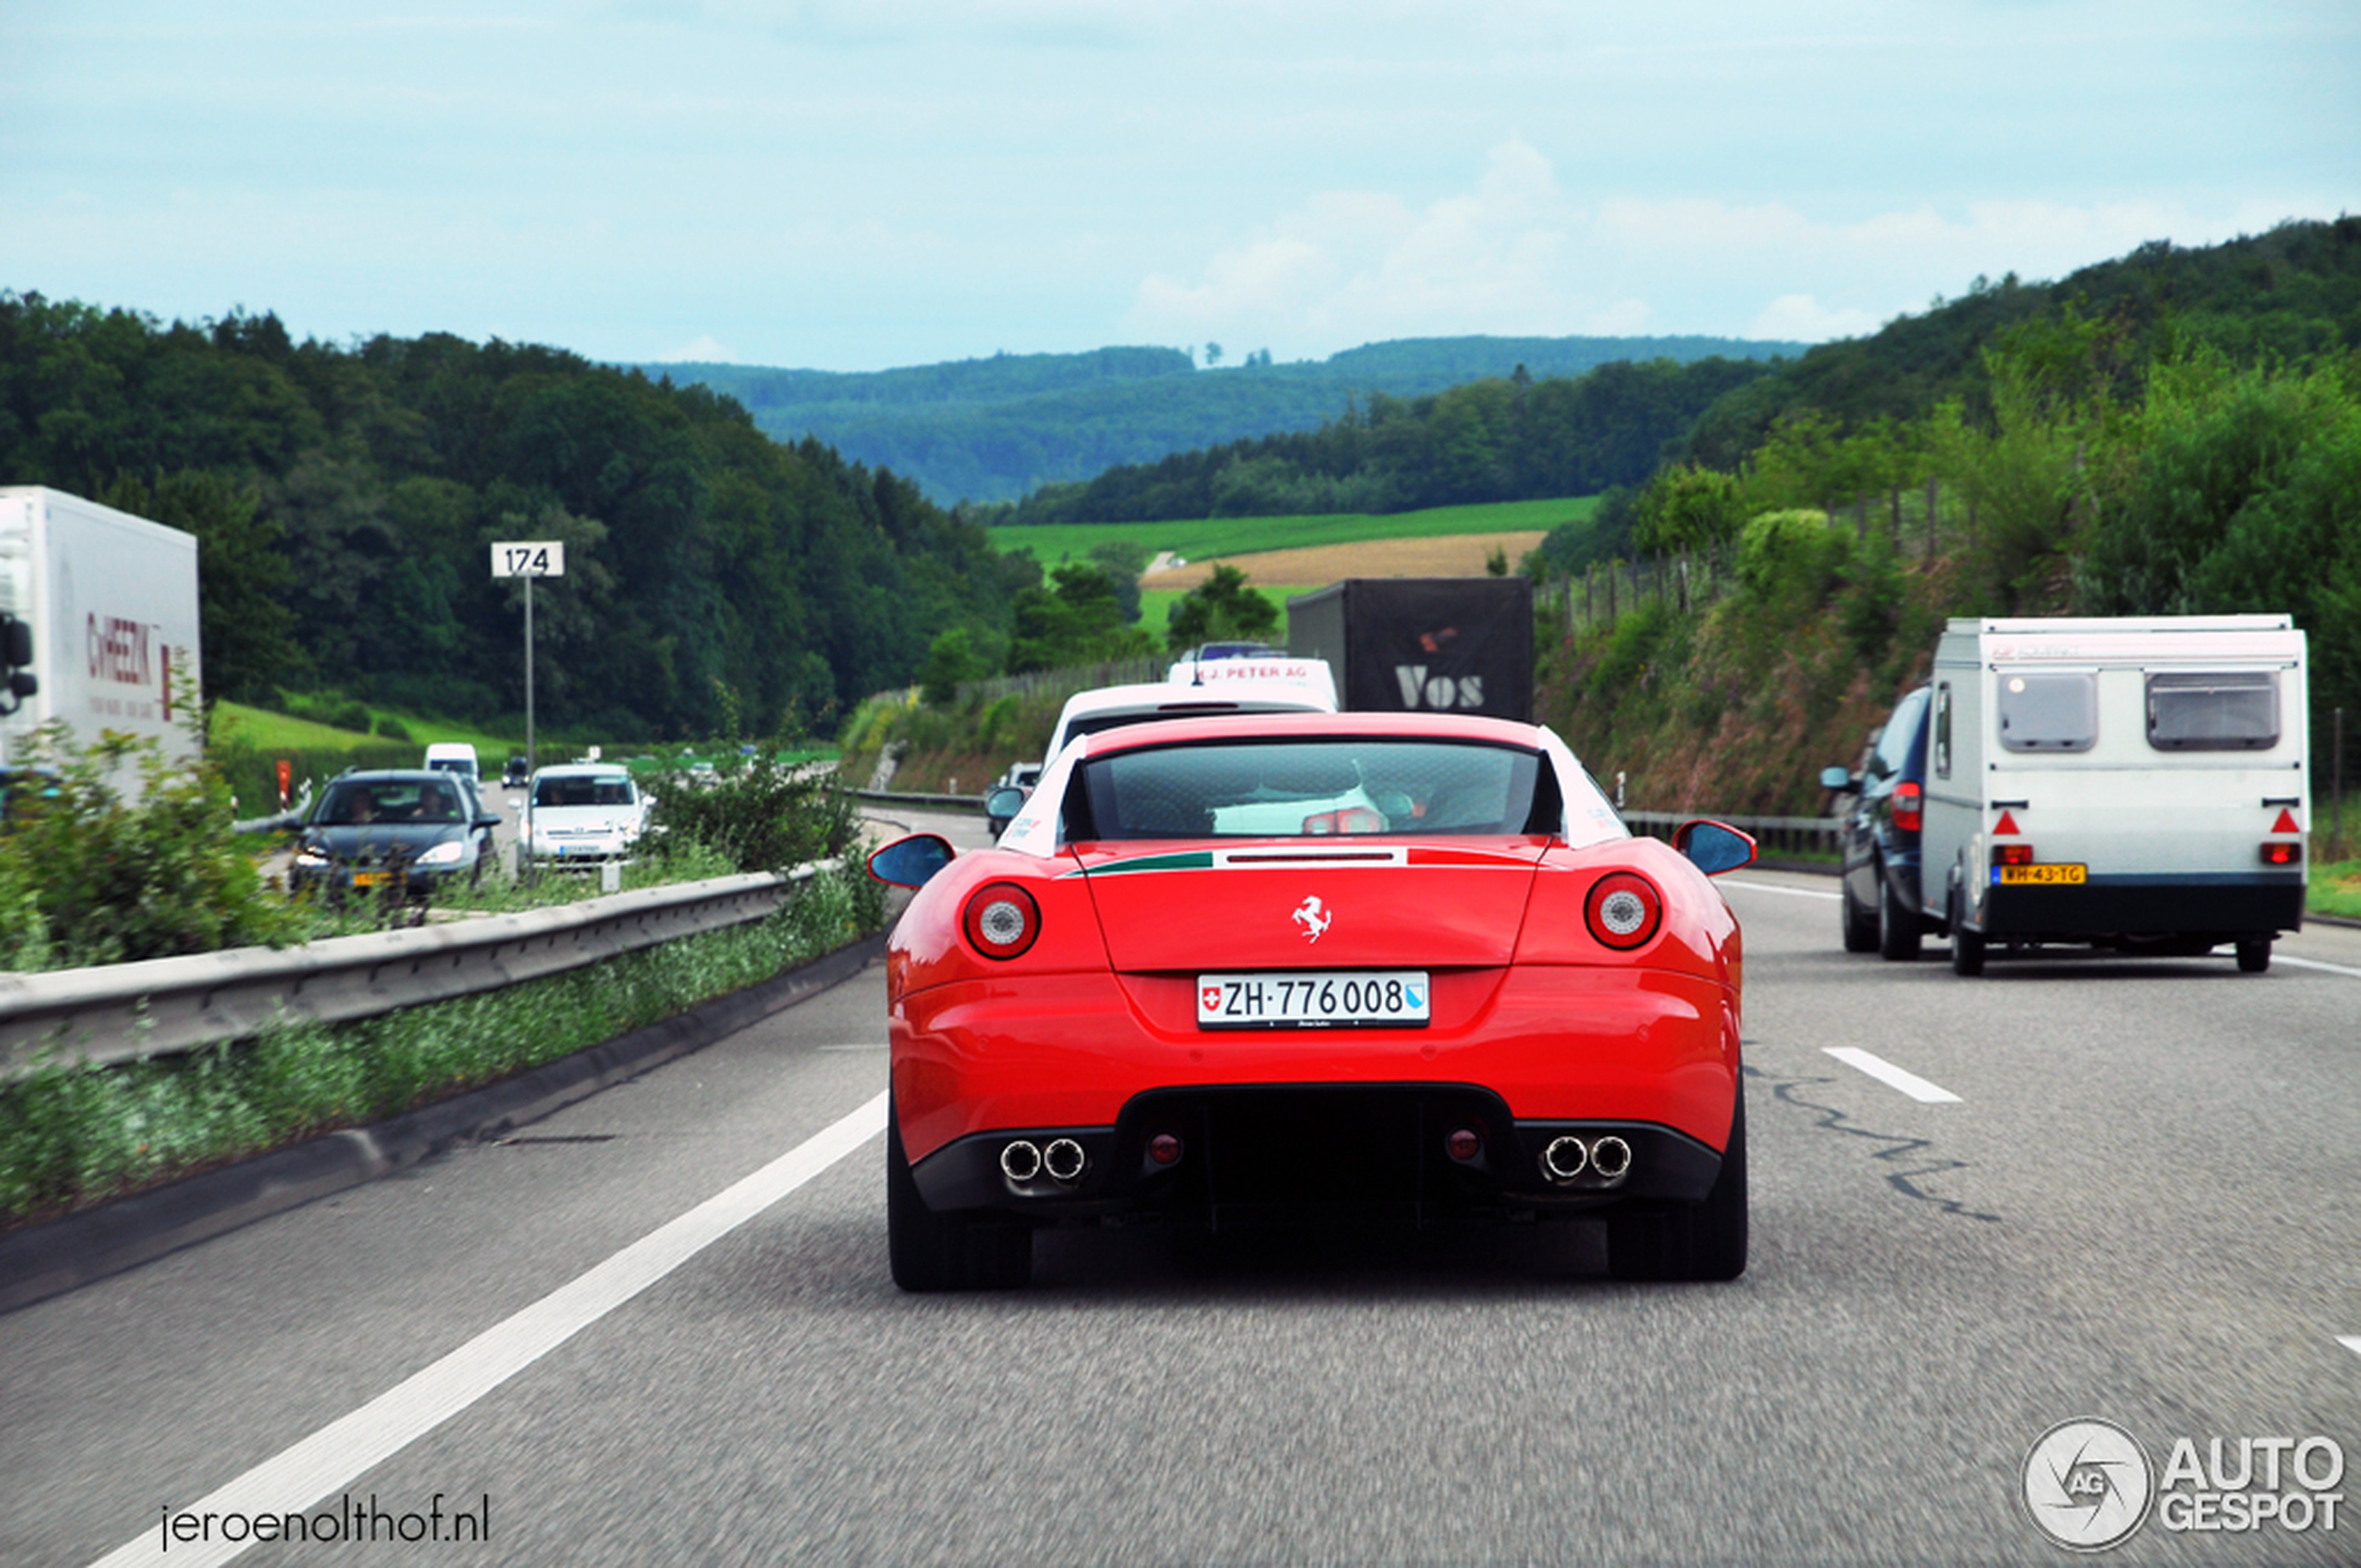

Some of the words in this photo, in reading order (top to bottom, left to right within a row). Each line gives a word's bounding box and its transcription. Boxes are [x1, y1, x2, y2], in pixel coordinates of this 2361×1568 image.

[506, 548, 549, 573] 174
[1226, 665, 1280, 679] PETER
[1286, 665, 1307, 679] AG
[1395, 665, 1484, 708] Vos
